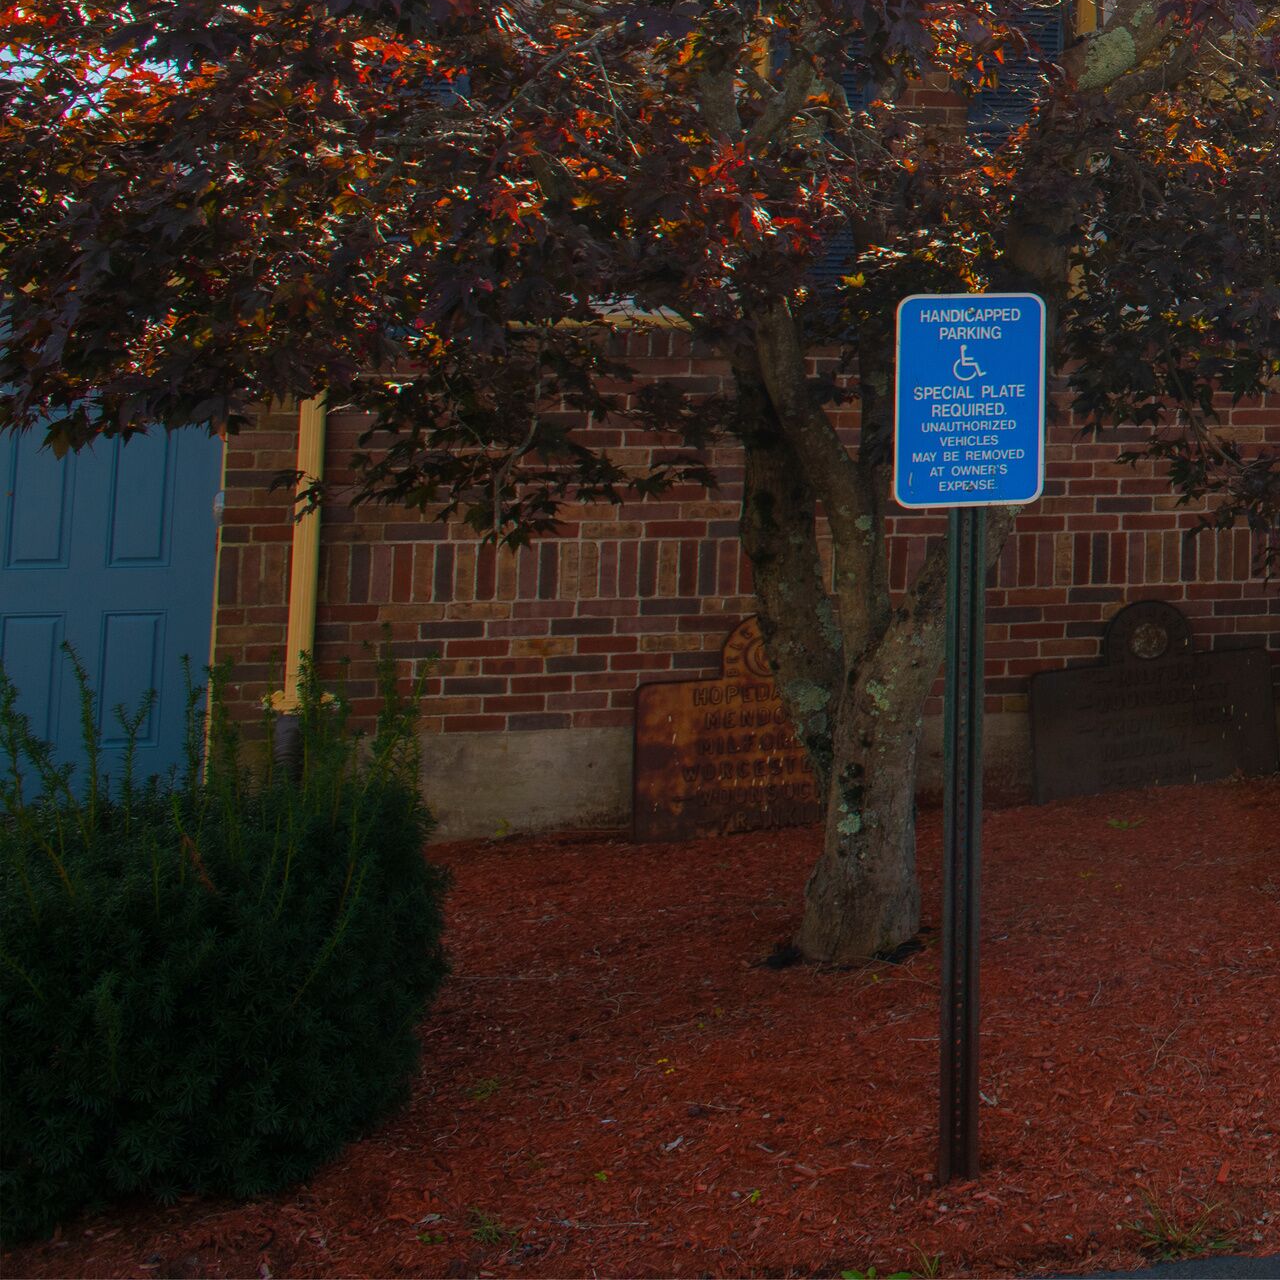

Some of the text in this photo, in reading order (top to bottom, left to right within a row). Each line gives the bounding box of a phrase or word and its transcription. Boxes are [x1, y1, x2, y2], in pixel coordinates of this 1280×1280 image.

[920, 308, 1021, 323] HANDICAPPED
[939, 326, 1002, 340] PARKING
[913, 384, 1026, 400] SPECIAL PLATE
[931, 403, 1007, 417] REQUIRED.
[921, 420, 1016, 433] UNAUTHORIZED
[939, 435, 999, 447] VEHICLES
[912, 449, 1025, 463] MAY BE REMOVED
[929, 464, 1008, 477] AT OWNER'S
[938, 479, 999, 491] EXPENSE.
[693, 685, 784, 707] HOPEDA
[704, 708, 788, 730] MENDO
[684, 756, 813, 782] WORCESTE
[698, 783, 824, 806] WOONSOC
[720, 805, 827, 830] FRANKLI
